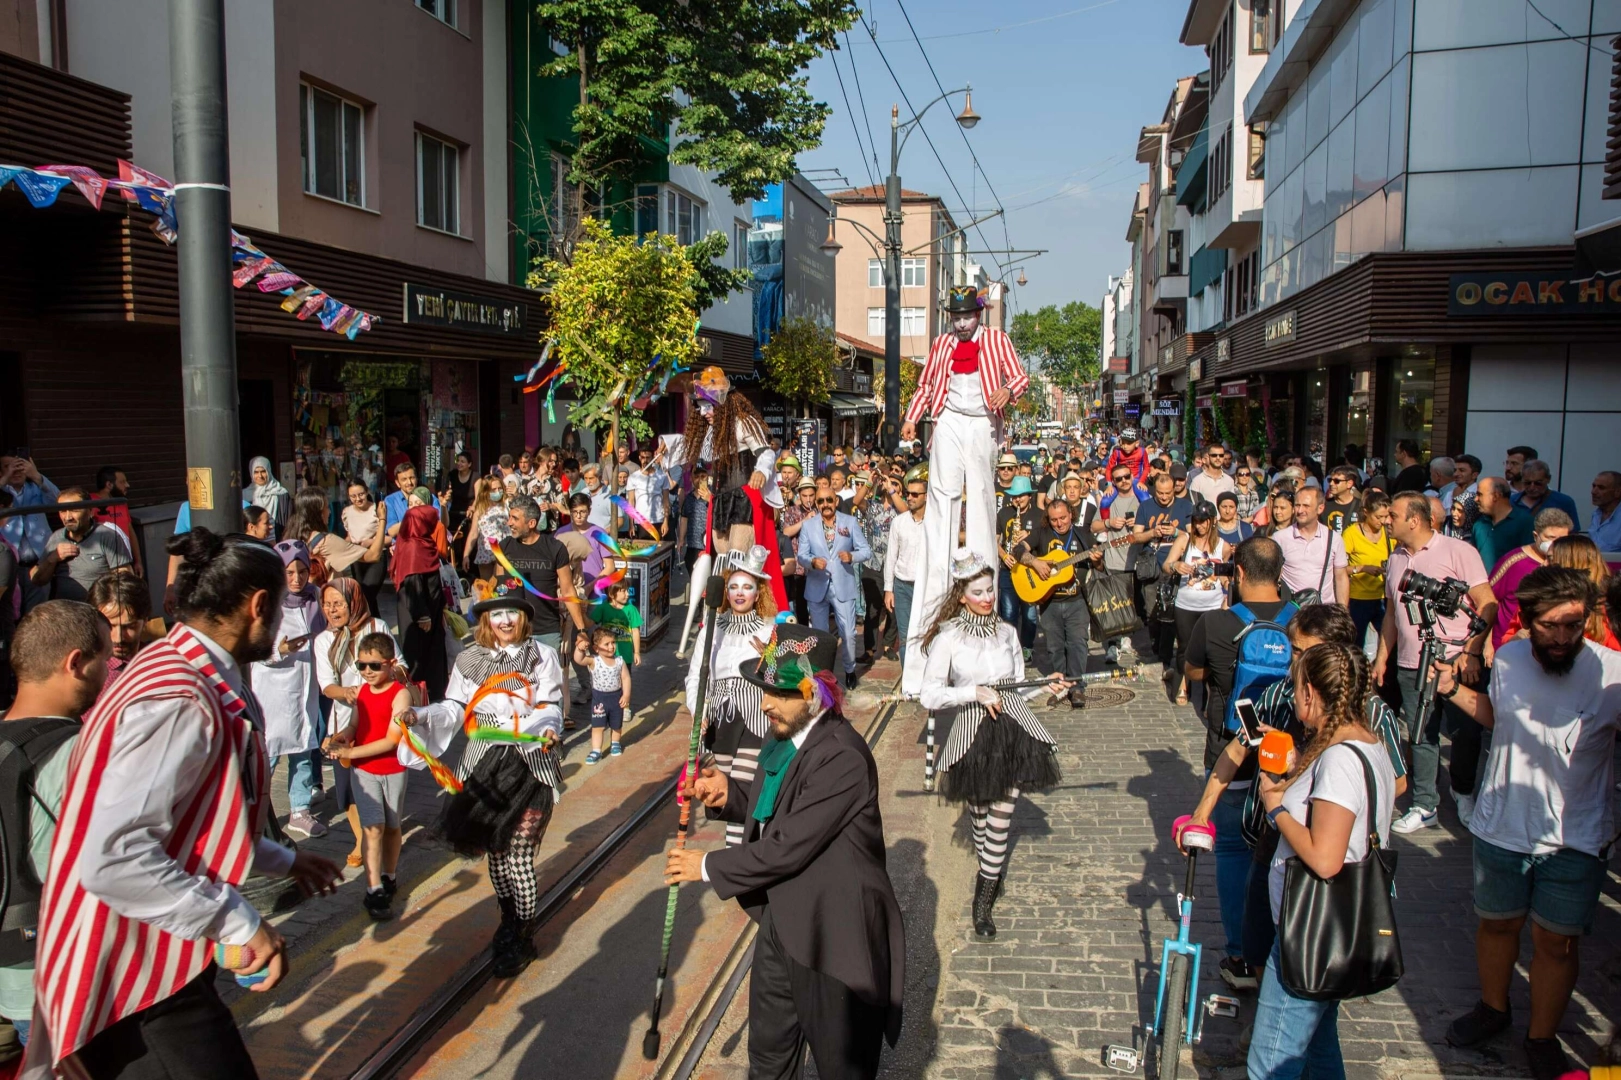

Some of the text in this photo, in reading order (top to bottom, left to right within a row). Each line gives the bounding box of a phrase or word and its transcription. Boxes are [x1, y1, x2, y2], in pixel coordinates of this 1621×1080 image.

[416, 292, 445, 318] YENİ
[1456, 280, 1566, 305] OCAK
[1159, 400, 1172, 408] SÖZ
